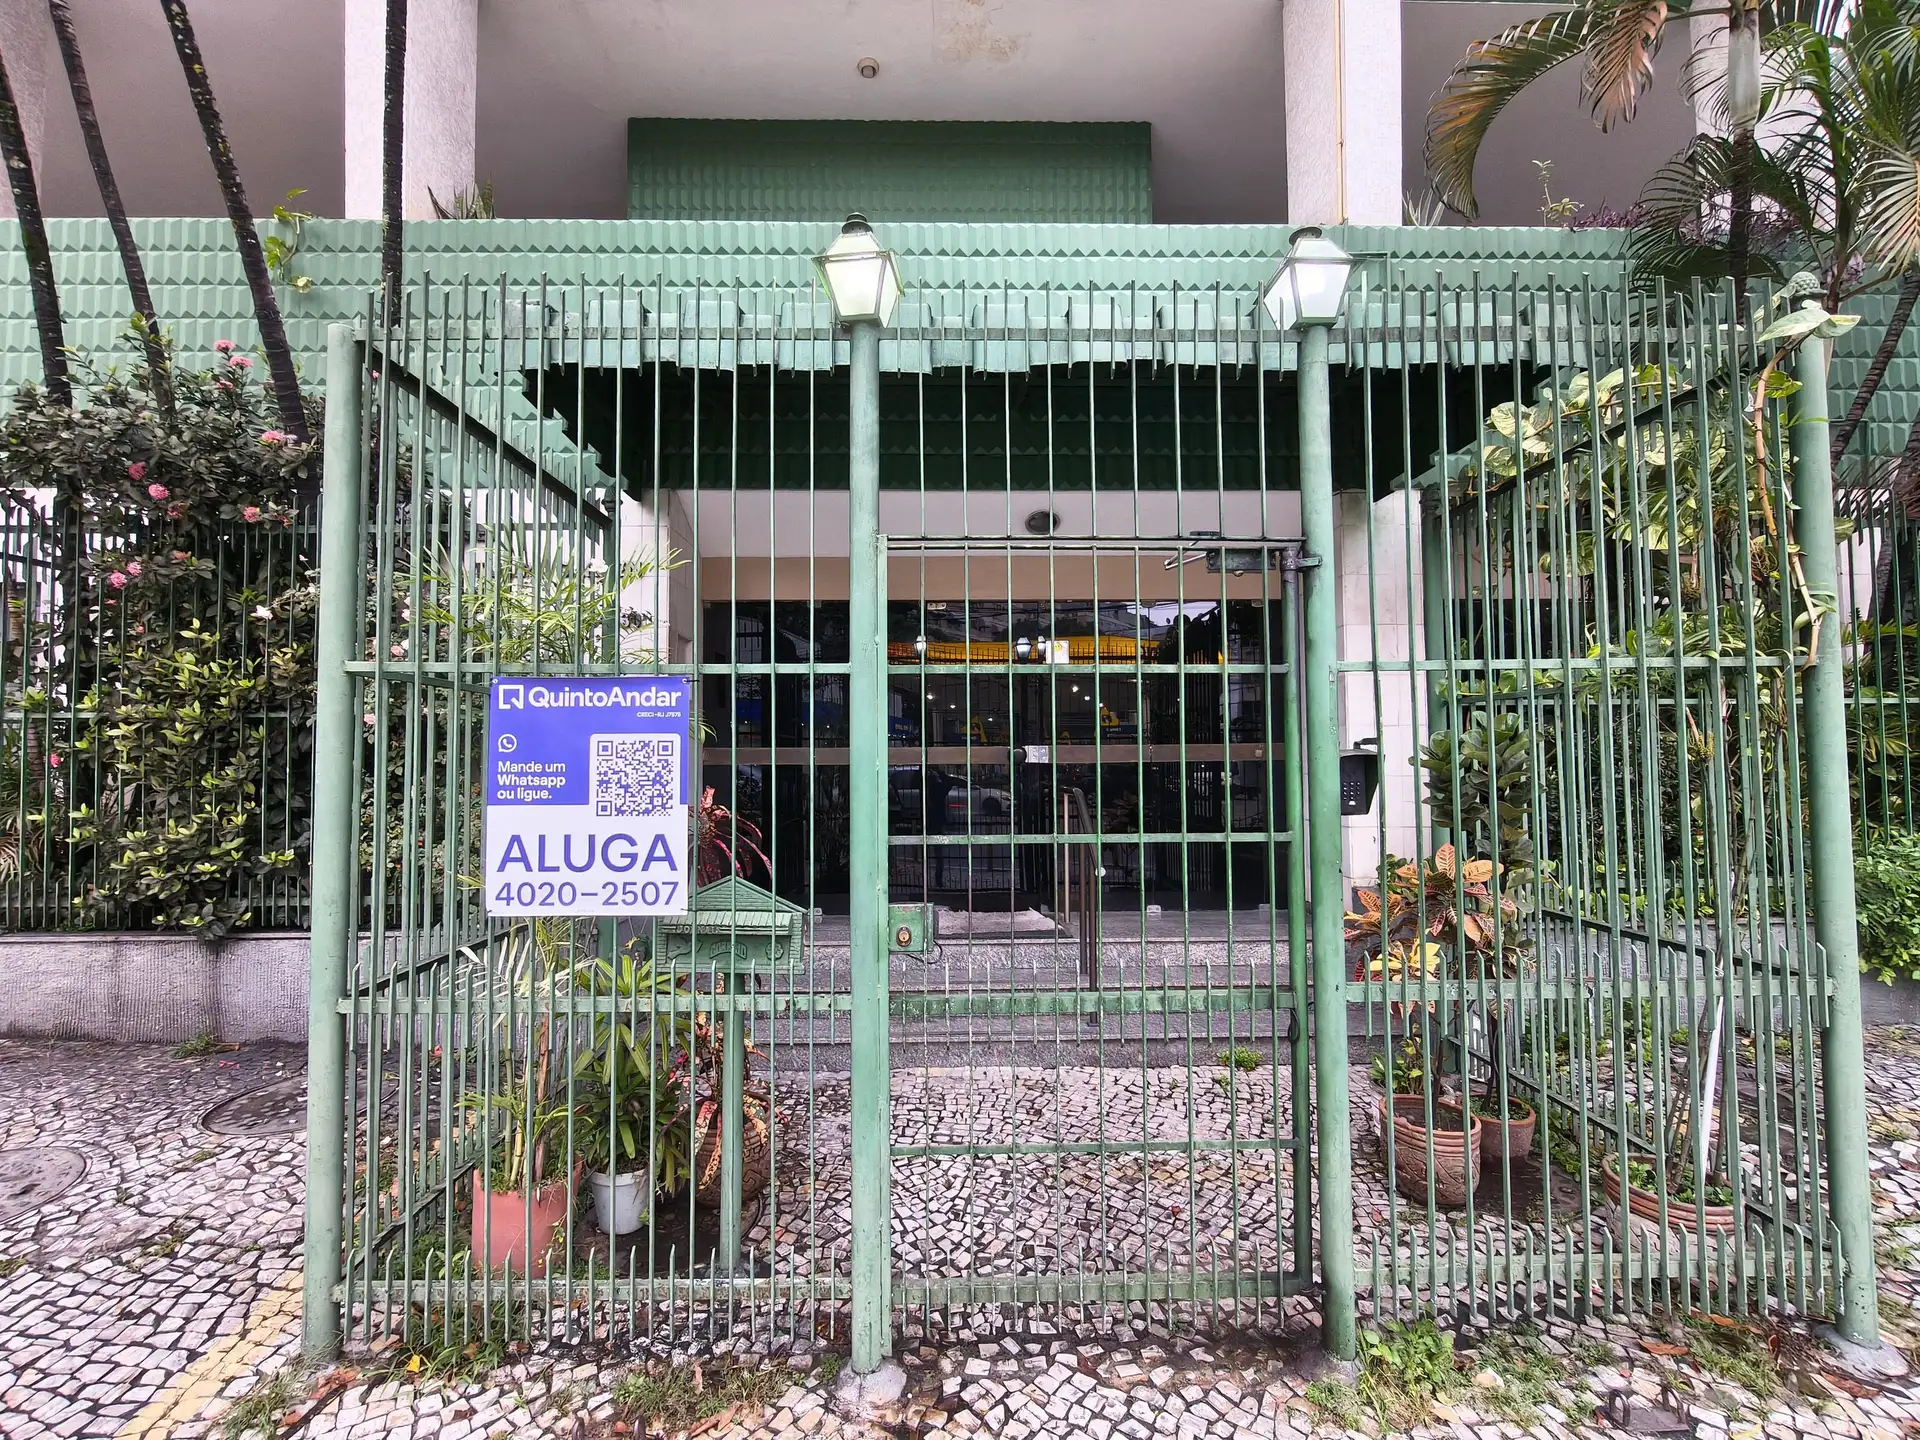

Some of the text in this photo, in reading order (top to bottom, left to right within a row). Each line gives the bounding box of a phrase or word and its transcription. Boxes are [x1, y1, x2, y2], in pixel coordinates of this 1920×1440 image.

[528, 686, 682, 709] QuintoAndar
[498, 761, 566, 773] Mande um
[497, 774, 566, 788] Whatsapp
[497, 787, 552, 801] ou ligue.
[496, 833, 678, 873] ALUGA
[495, 881, 679, 907] 4020-2507
